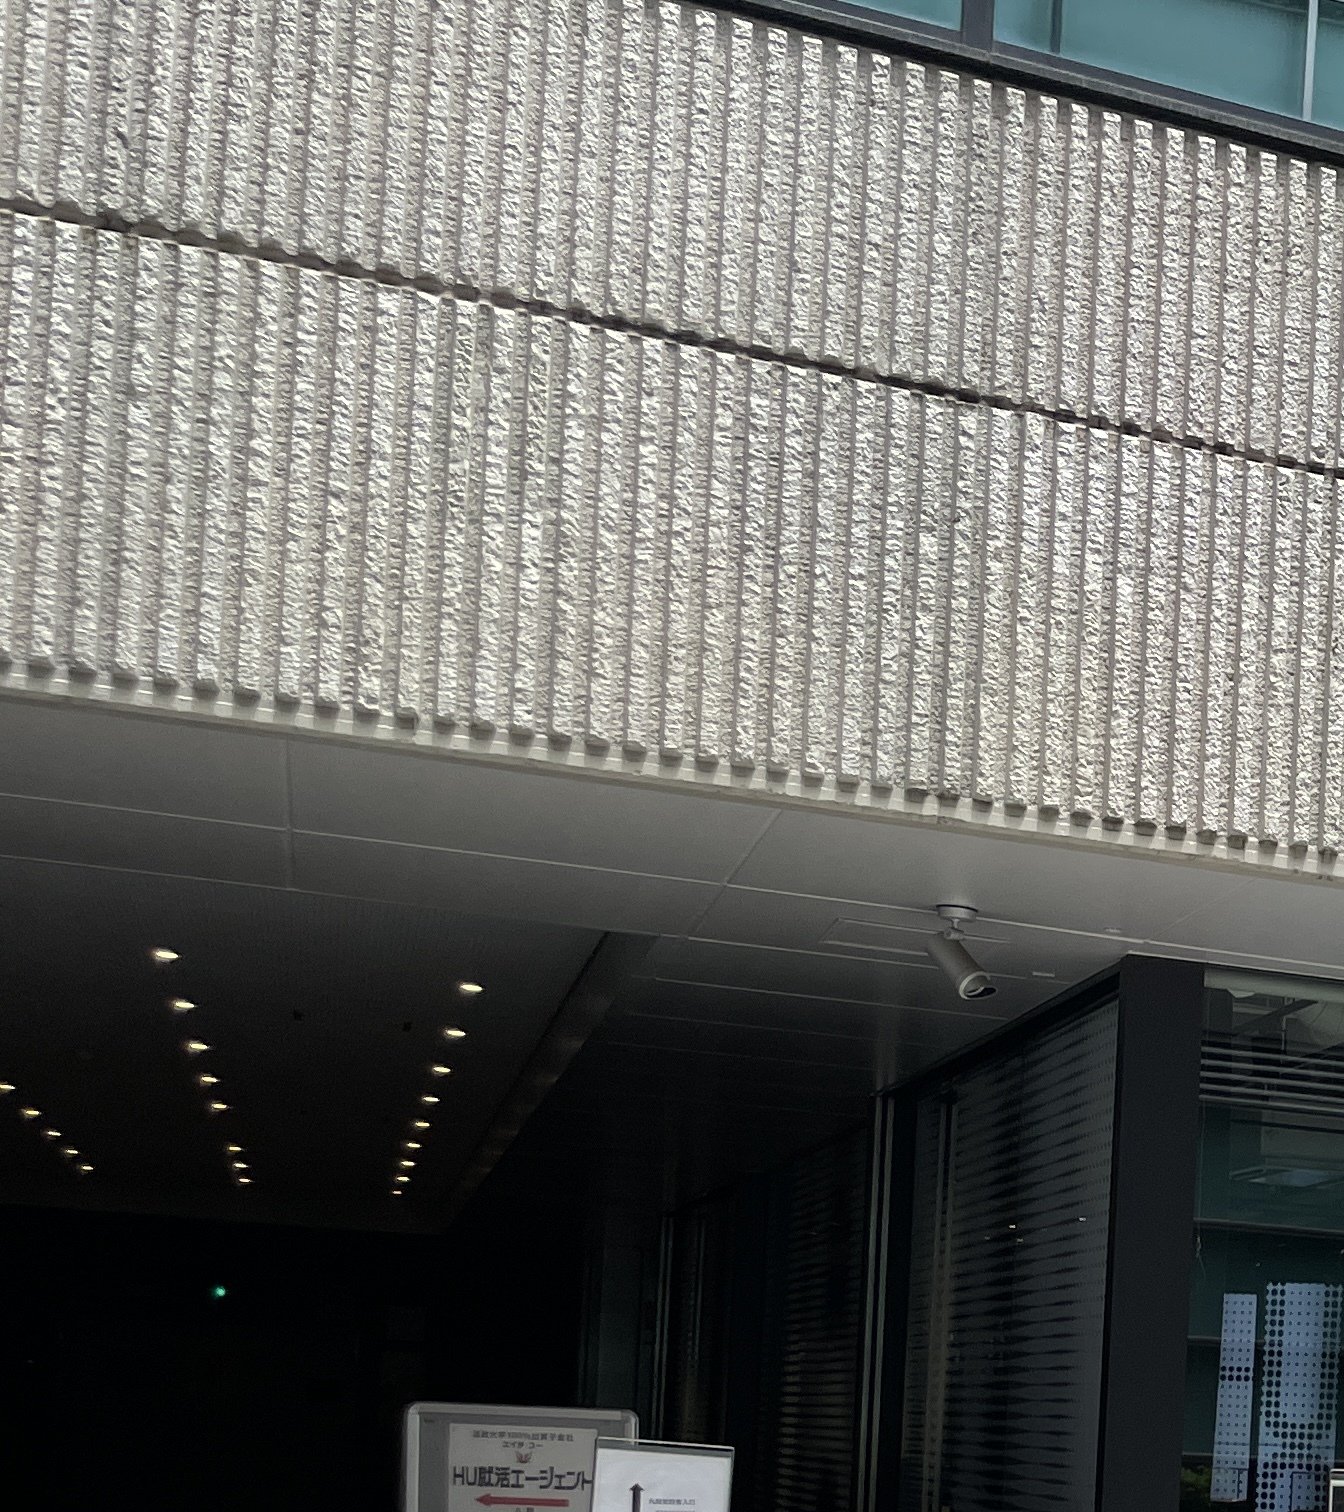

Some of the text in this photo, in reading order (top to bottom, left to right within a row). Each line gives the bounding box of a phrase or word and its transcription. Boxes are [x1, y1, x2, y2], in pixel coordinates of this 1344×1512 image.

[453, 1466, 592, 1490] HU就活エージェント
